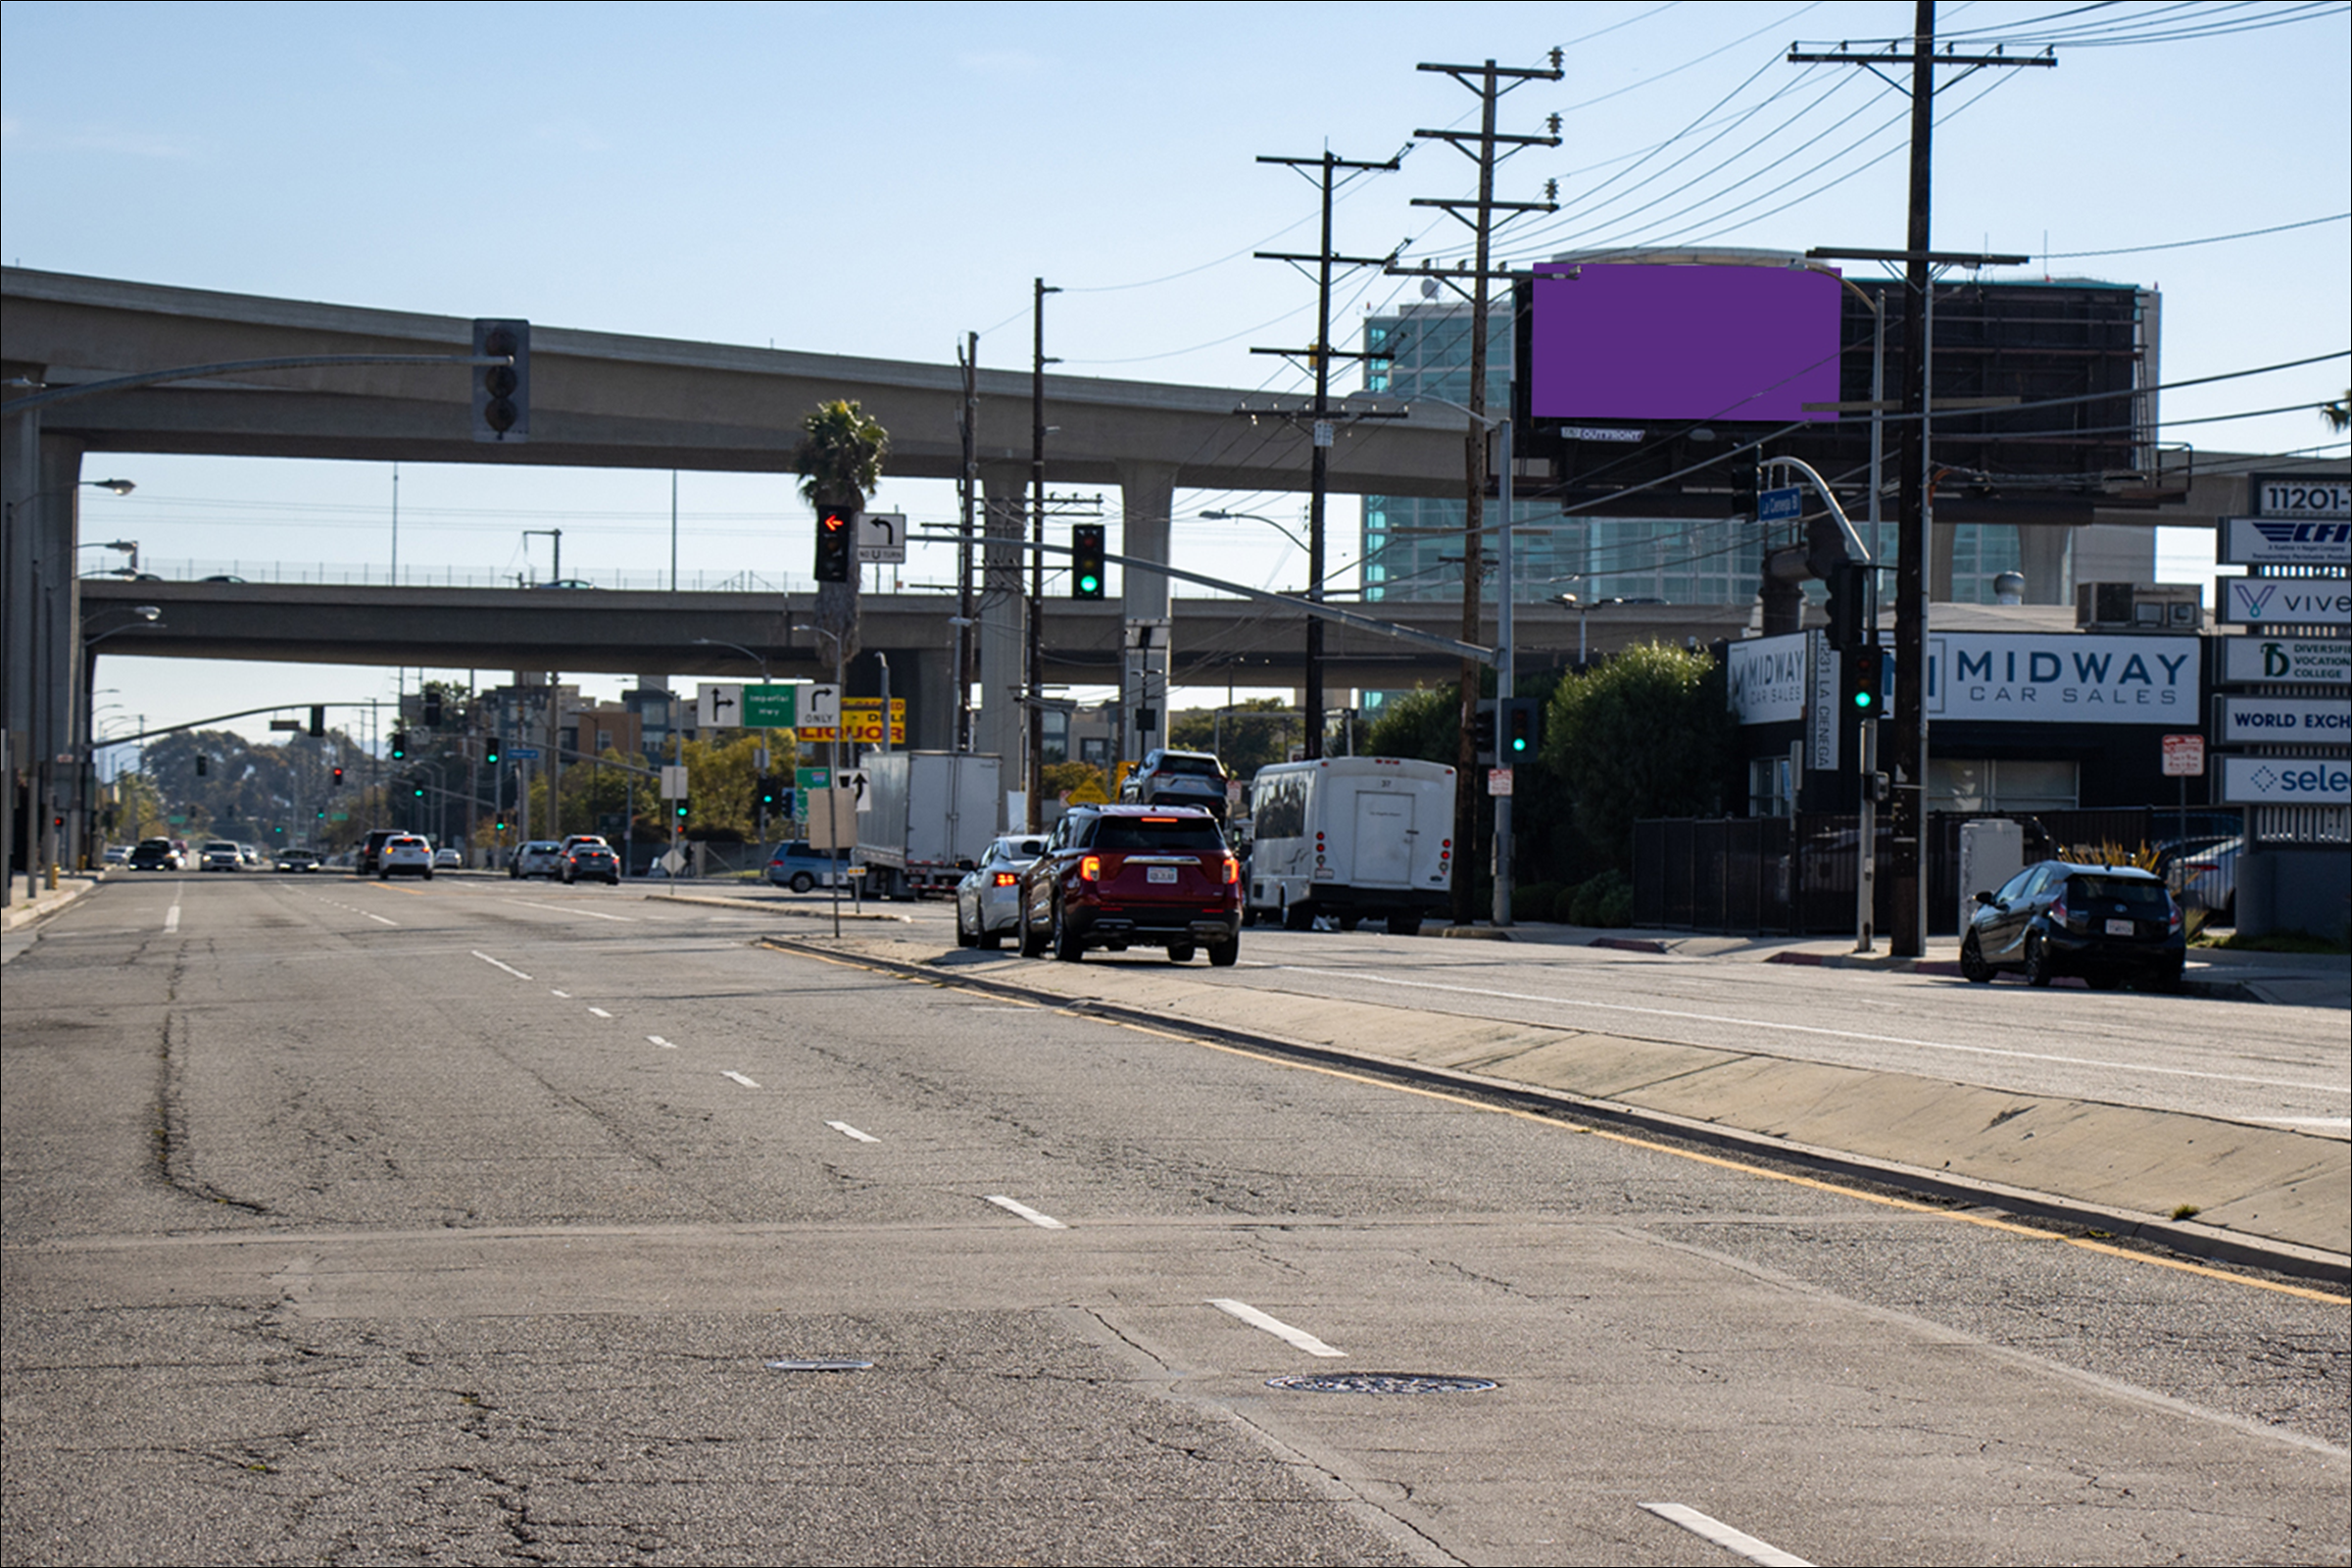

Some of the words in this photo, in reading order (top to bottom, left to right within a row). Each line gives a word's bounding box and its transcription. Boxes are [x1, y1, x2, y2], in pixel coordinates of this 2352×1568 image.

[2268, 488, 2351, 510] 11201-
[1748, 650, 1804, 687] MIDWAY
[1957, 650, 2188, 686] MIDWAY
[2293, 668, 2343, 679] COLLEGE
[1750, 690, 1767, 706] CAR
[1772, 686, 1801, 704] SALES
[1818, 680, 1831, 699] LA
[1969, 686, 2036, 703] CAR
[2062, 688, 2177, 705] SALES
[805, 713, 833, 724] ONLY
[867, 713, 905, 723] DLI
[2234, 712, 2297, 727] WORLD
[1817, 706, 1831, 766] CIENEGA
[2280, 763, 2351, 793] sele
